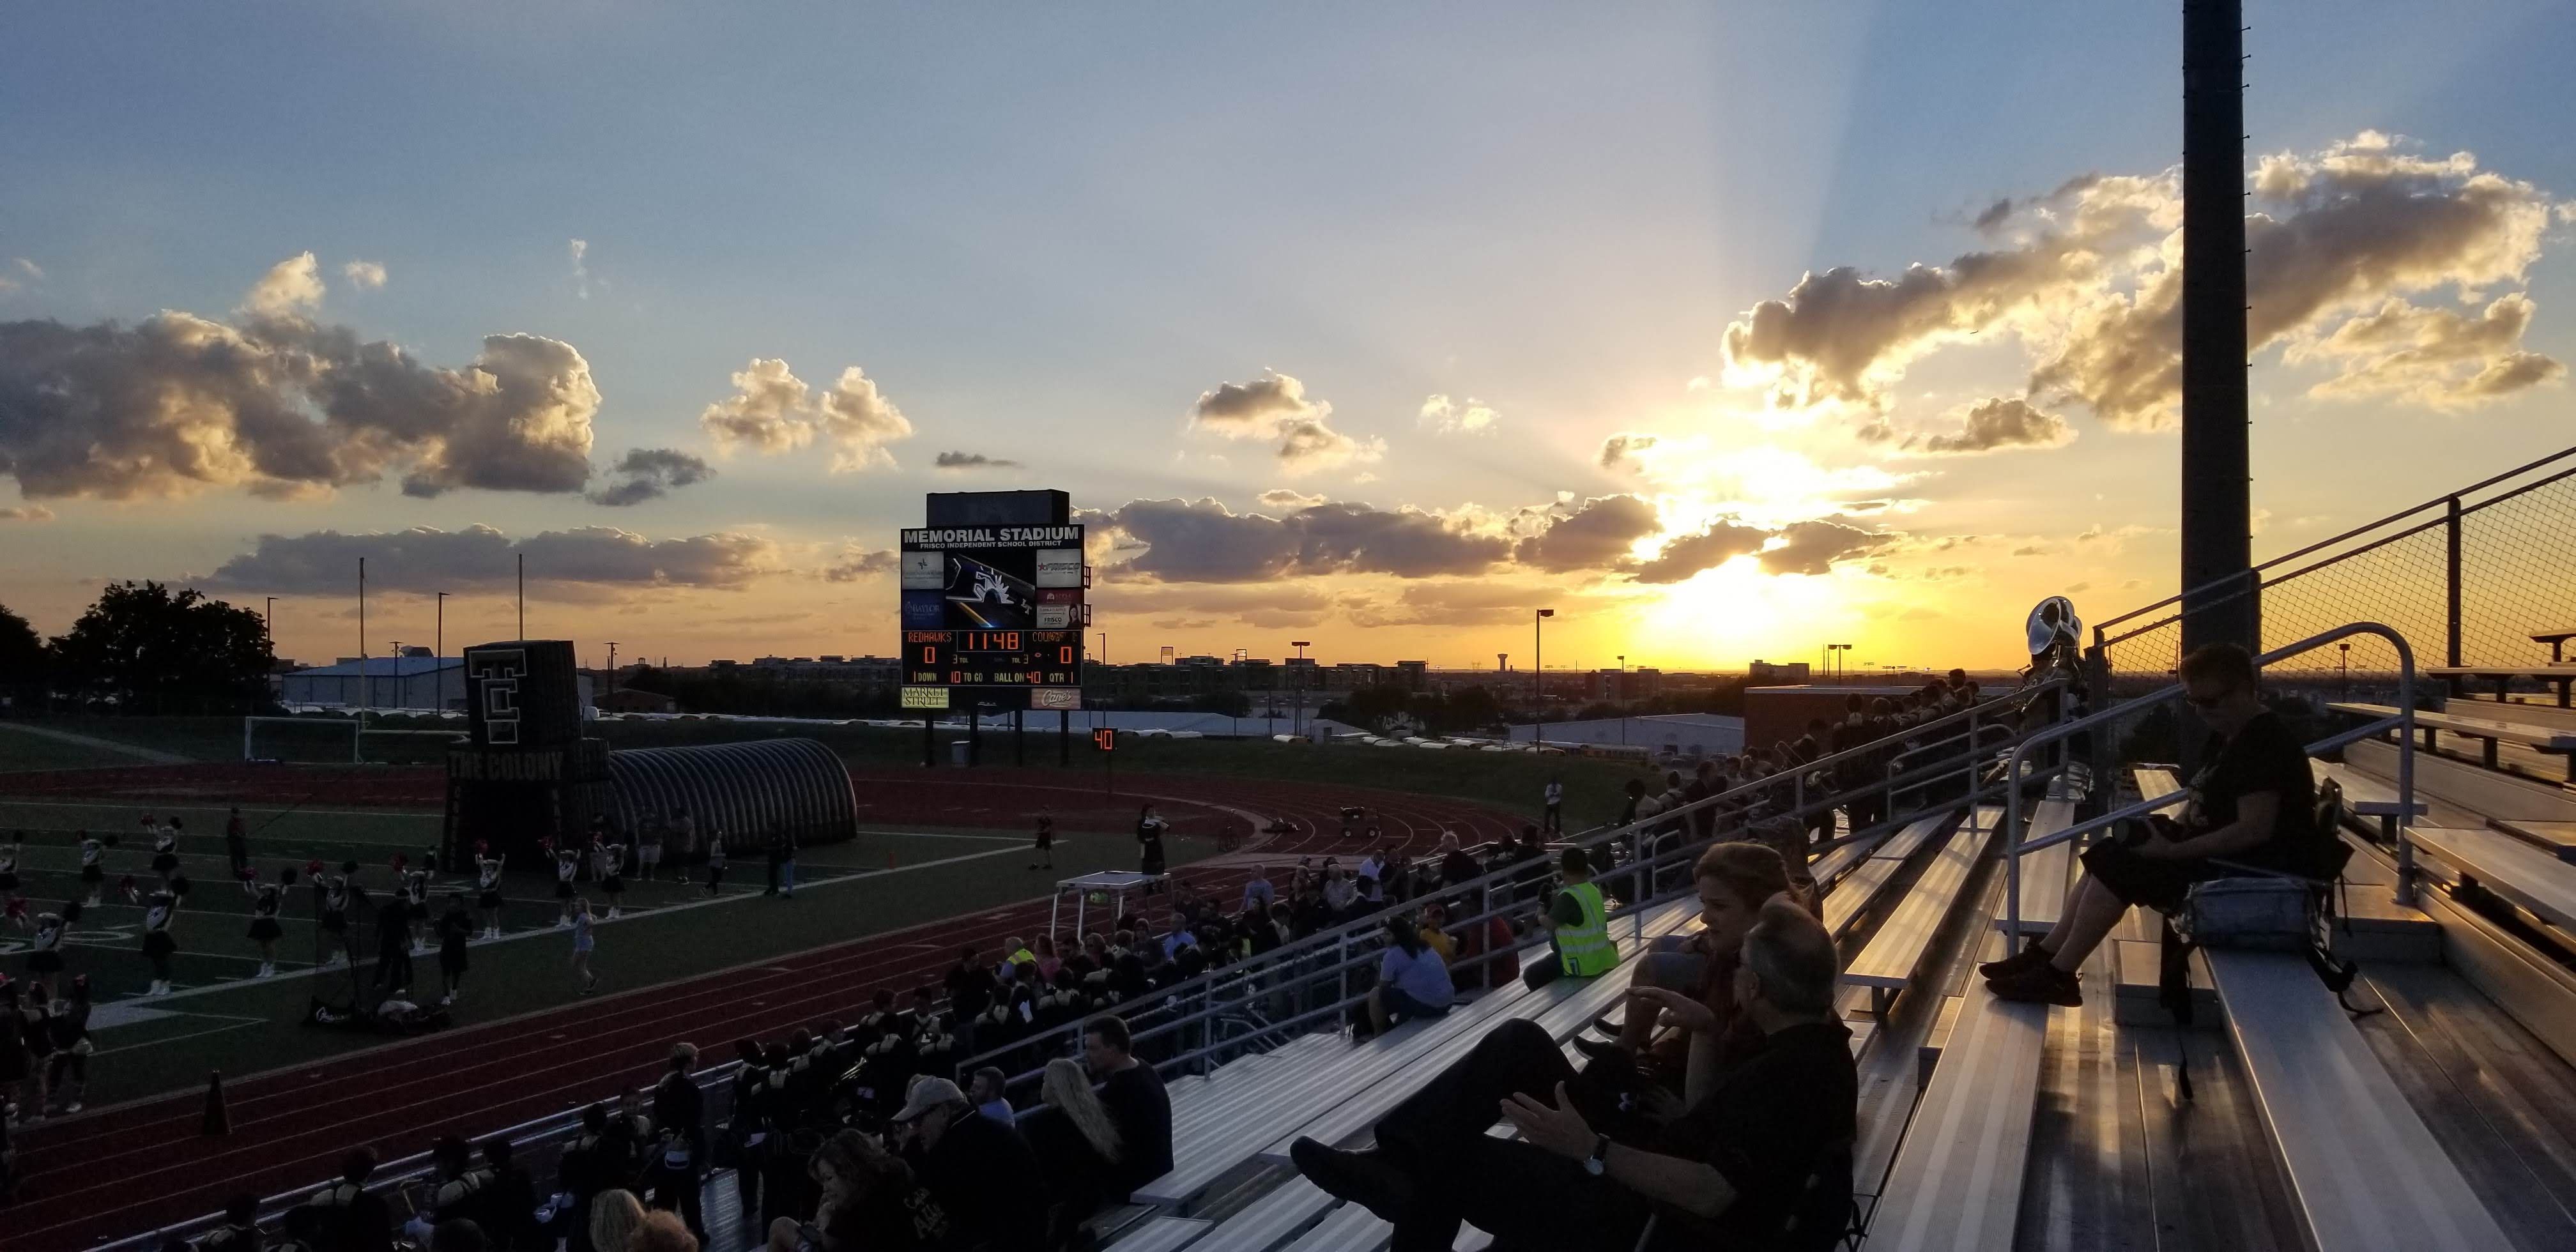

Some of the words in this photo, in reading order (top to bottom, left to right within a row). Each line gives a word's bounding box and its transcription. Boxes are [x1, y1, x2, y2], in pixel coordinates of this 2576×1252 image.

[904, 530, 995, 543] MEMORIAL
[1000, 527, 1078, 541] STADIUM
[908, 632, 953, 643] REDHAWKS
[924, 646, 935, 664] 0
[1060, 646, 1072, 664] 0
[918, 673, 937, 682] DOWN
[951, 671, 961, 683] 10
[963, 673, 972, 682] TO
[974, 673, 983, 682] GO
[994, 673, 1013, 682] BALL
[1014, 673, 1025, 682] ON
[1026, 671, 1041, 684] 40
[1049, 673, 1064, 683] QTR
[903, 687, 944, 698] MARKET
[1041, 690, 1073, 706] Cane's
[905, 696, 940, 706] STREET
[1094, 730, 1113, 750] 40
[448, 751, 482, 778] THE
[486, 751, 564, 781] COLONY
